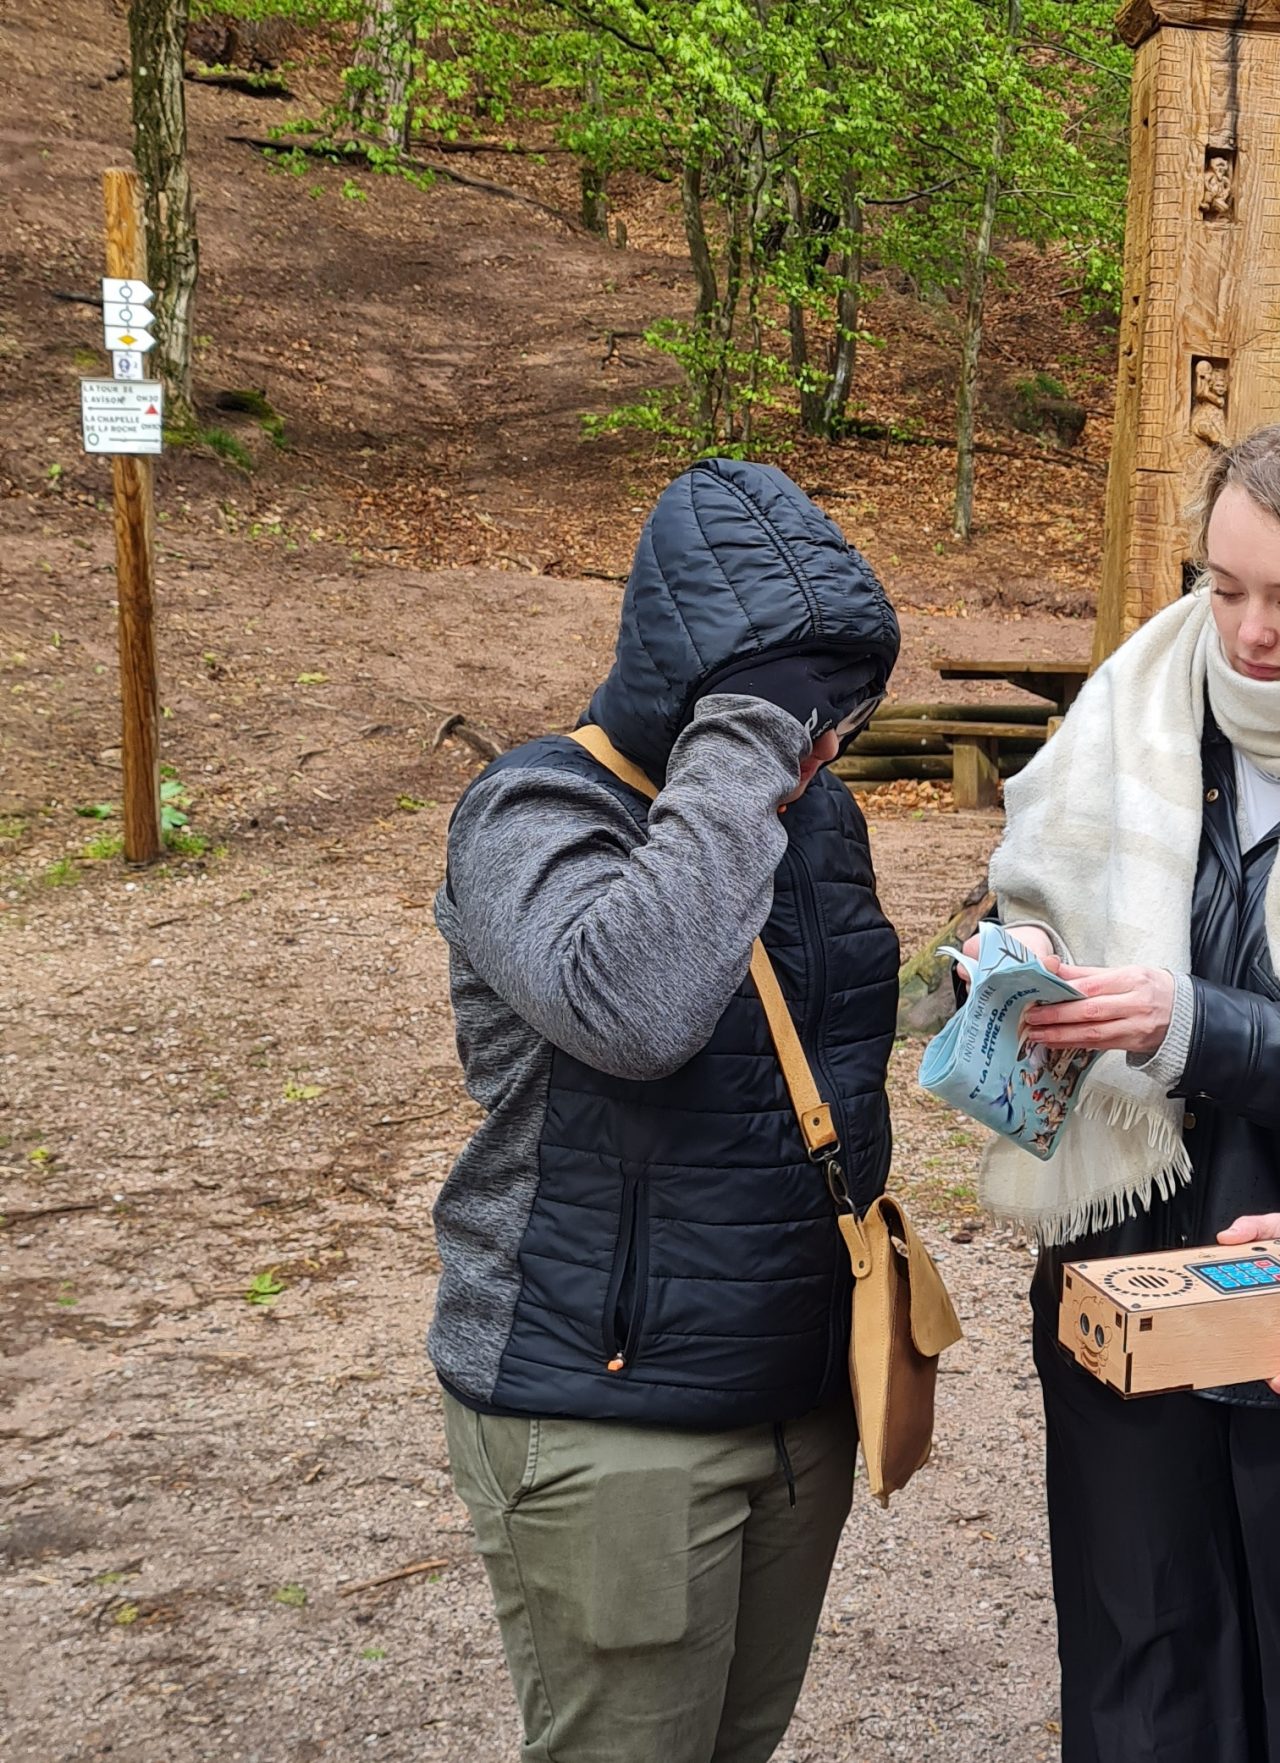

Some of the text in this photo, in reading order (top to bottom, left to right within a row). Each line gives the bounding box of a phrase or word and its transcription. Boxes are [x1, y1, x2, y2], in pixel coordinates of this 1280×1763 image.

[96, 385, 118, 393] TOUR
[97, 416, 140, 424] CHAPELLE
[980, 1008, 999, 1055] HAROLD
[969, 1085, 981, 1100] ET
[979, 1069, 989, 1085] LA
[985, 1023, 1001, 1067] LETTRE
